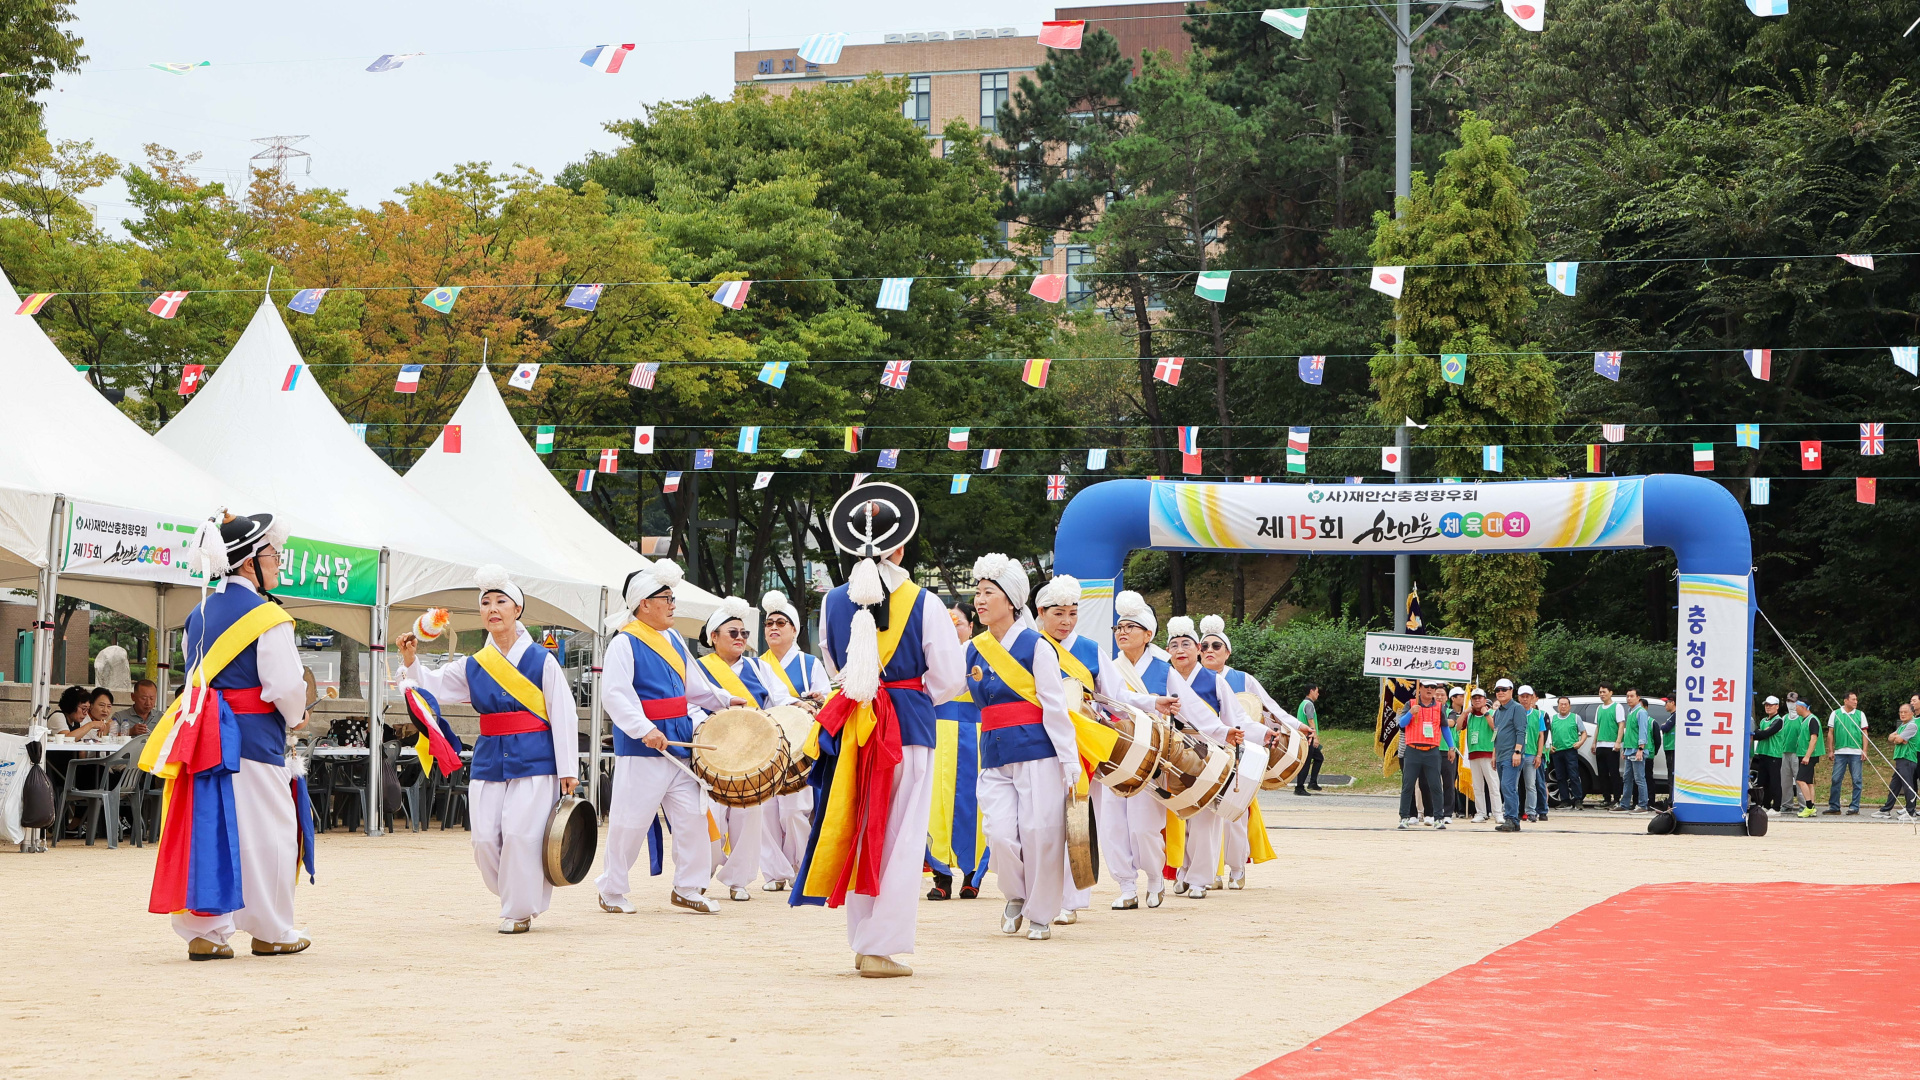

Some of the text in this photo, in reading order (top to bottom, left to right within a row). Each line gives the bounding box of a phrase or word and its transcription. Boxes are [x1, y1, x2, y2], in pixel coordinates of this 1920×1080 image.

[1256, 509, 1526, 544] 제15회 한마음 체육대회
[73, 542, 102, 560] 제15회
[1370, 656, 1402, 668] 제15회
[1684, 604, 1707, 737] 충청인은
[1709, 677, 1736, 768] 최고다
